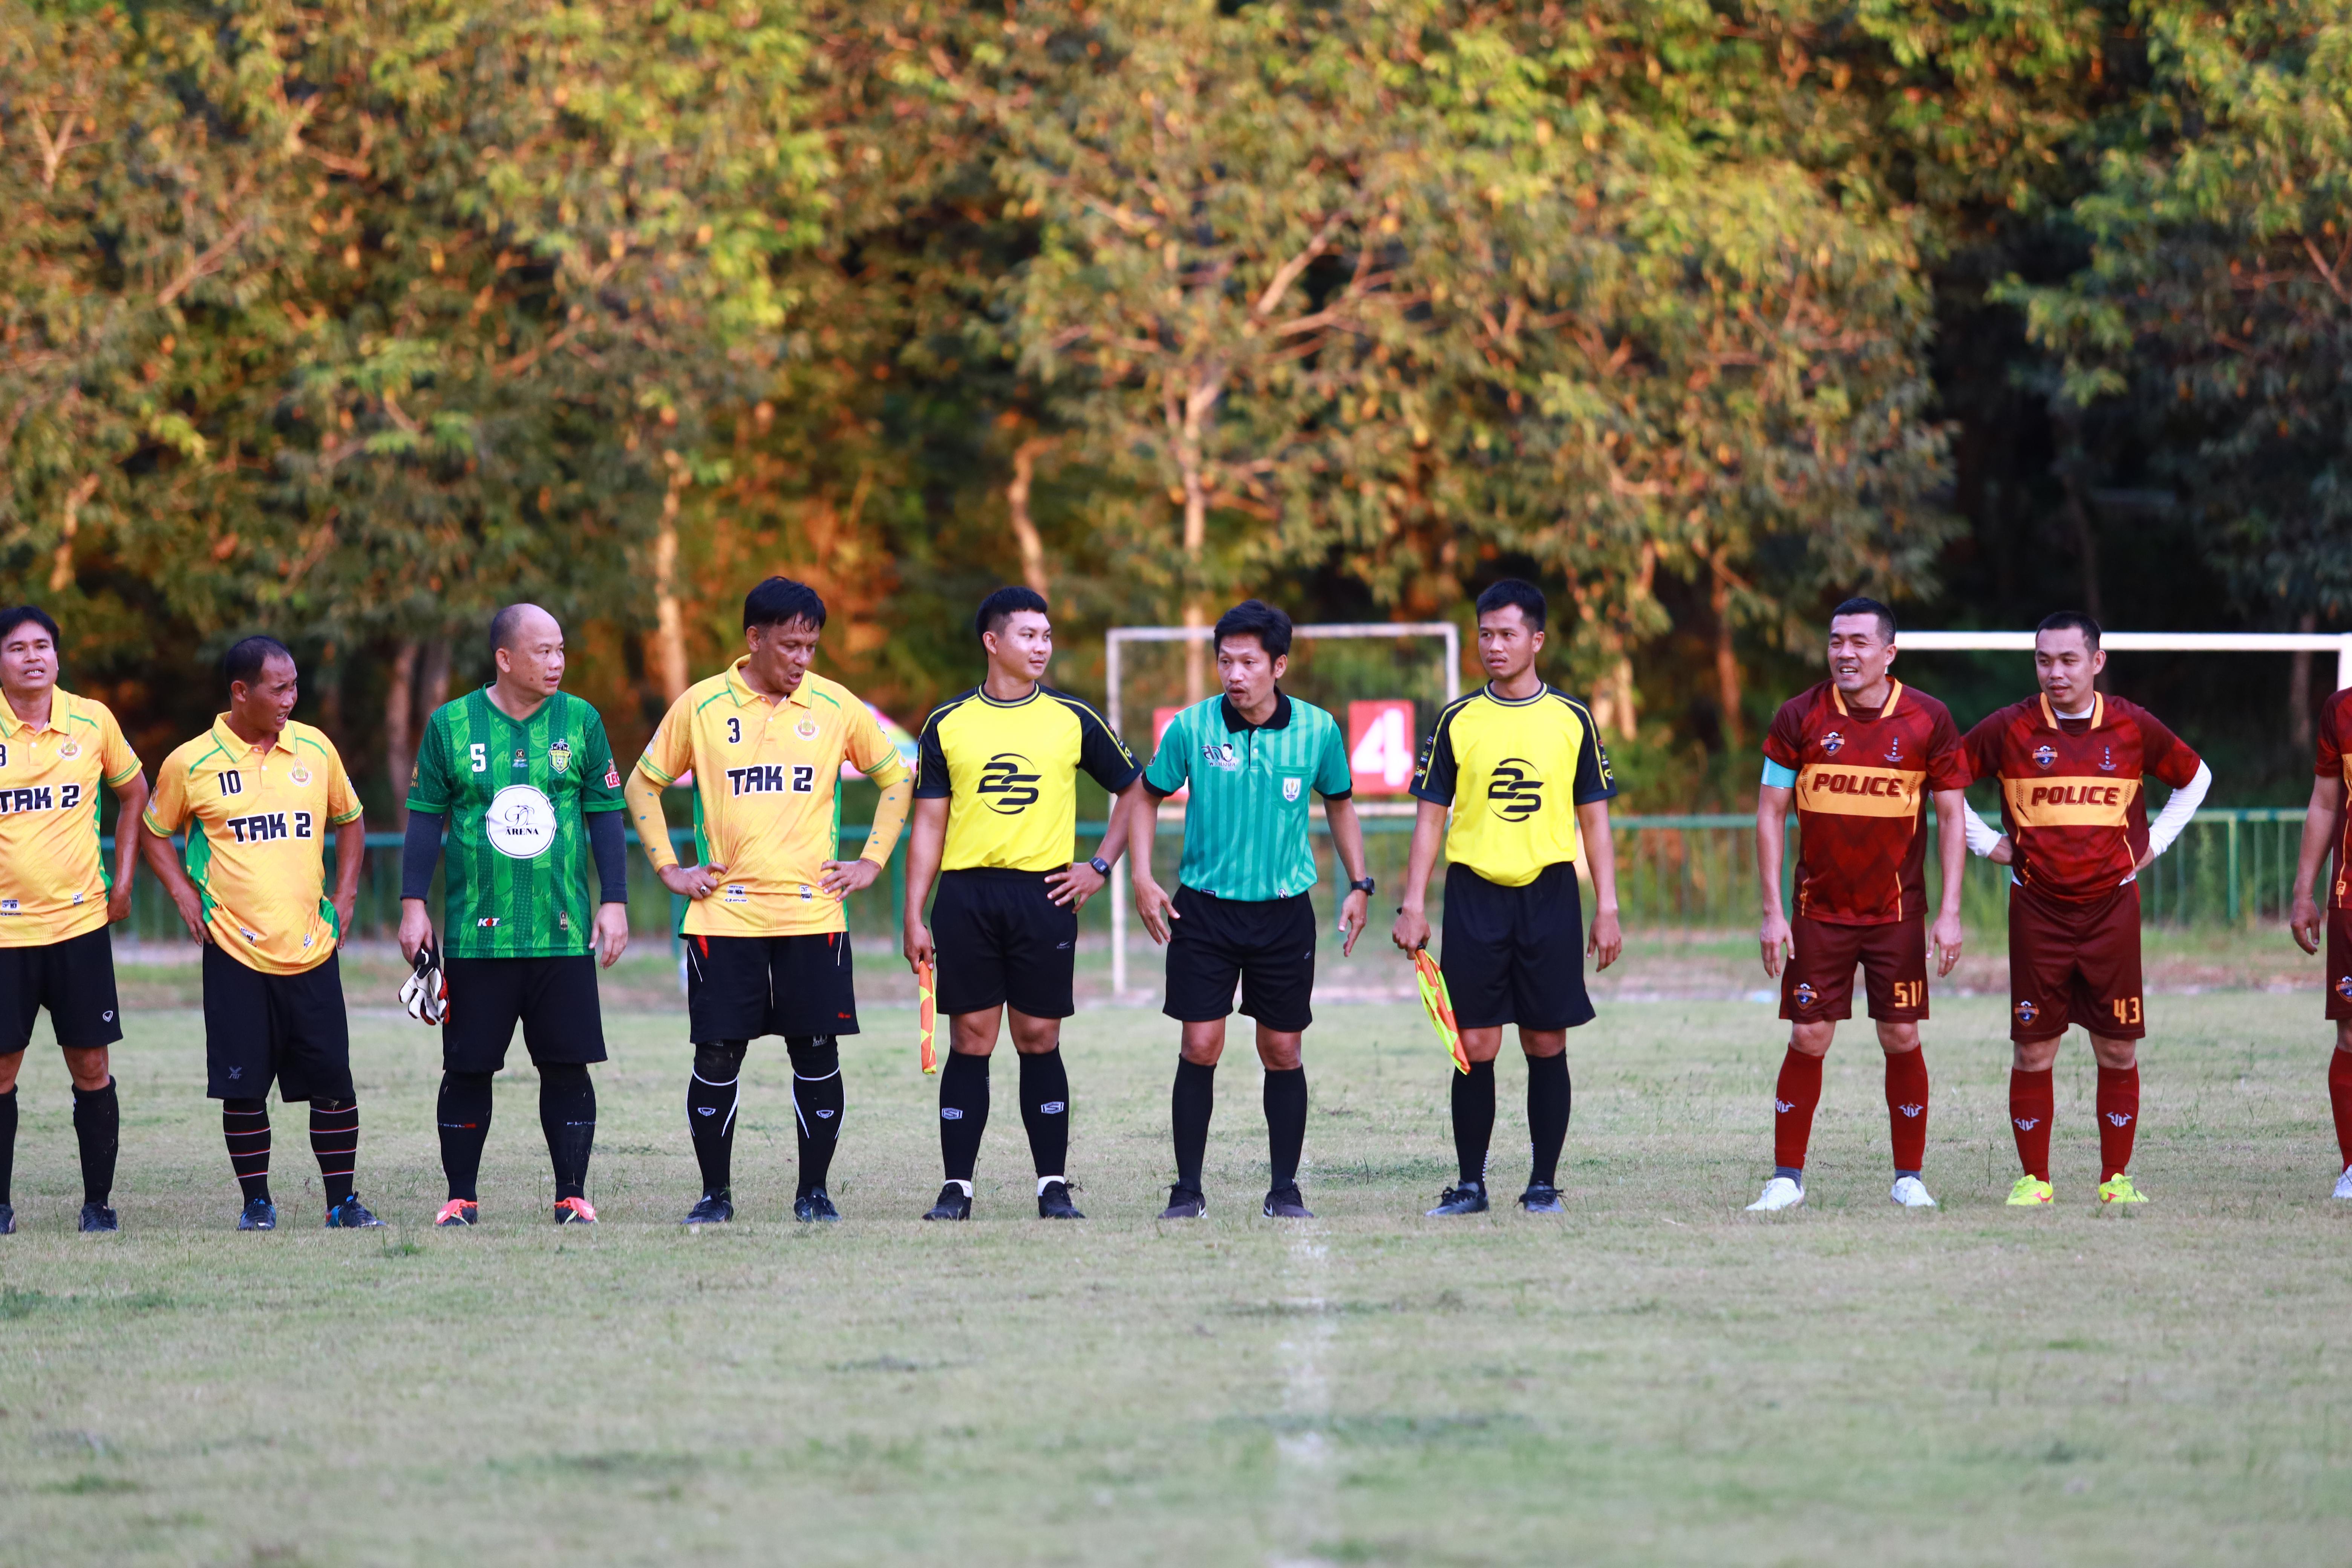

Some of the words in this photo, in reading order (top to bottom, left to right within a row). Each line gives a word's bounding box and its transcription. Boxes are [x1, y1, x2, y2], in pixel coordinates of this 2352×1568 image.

[727, 718, 740, 743] 3
[470, 743, 486, 772] 5
[1351, 707, 1413, 786] 4
[218, 770, 241, 796] 10
[727, 766, 783, 796] TAK
[793, 767, 813, 792] 2
[1812, 773, 1904, 797] POLICE
[0, 787, 52, 813] TAK
[61, 785, 80, 808] 2
[2031, 786, 2120, 806] POLICE
[227, 813, 287, 842] TAK
[294, 813, 311, 838] 2
[2113, 997, 2140, 1024] 43
